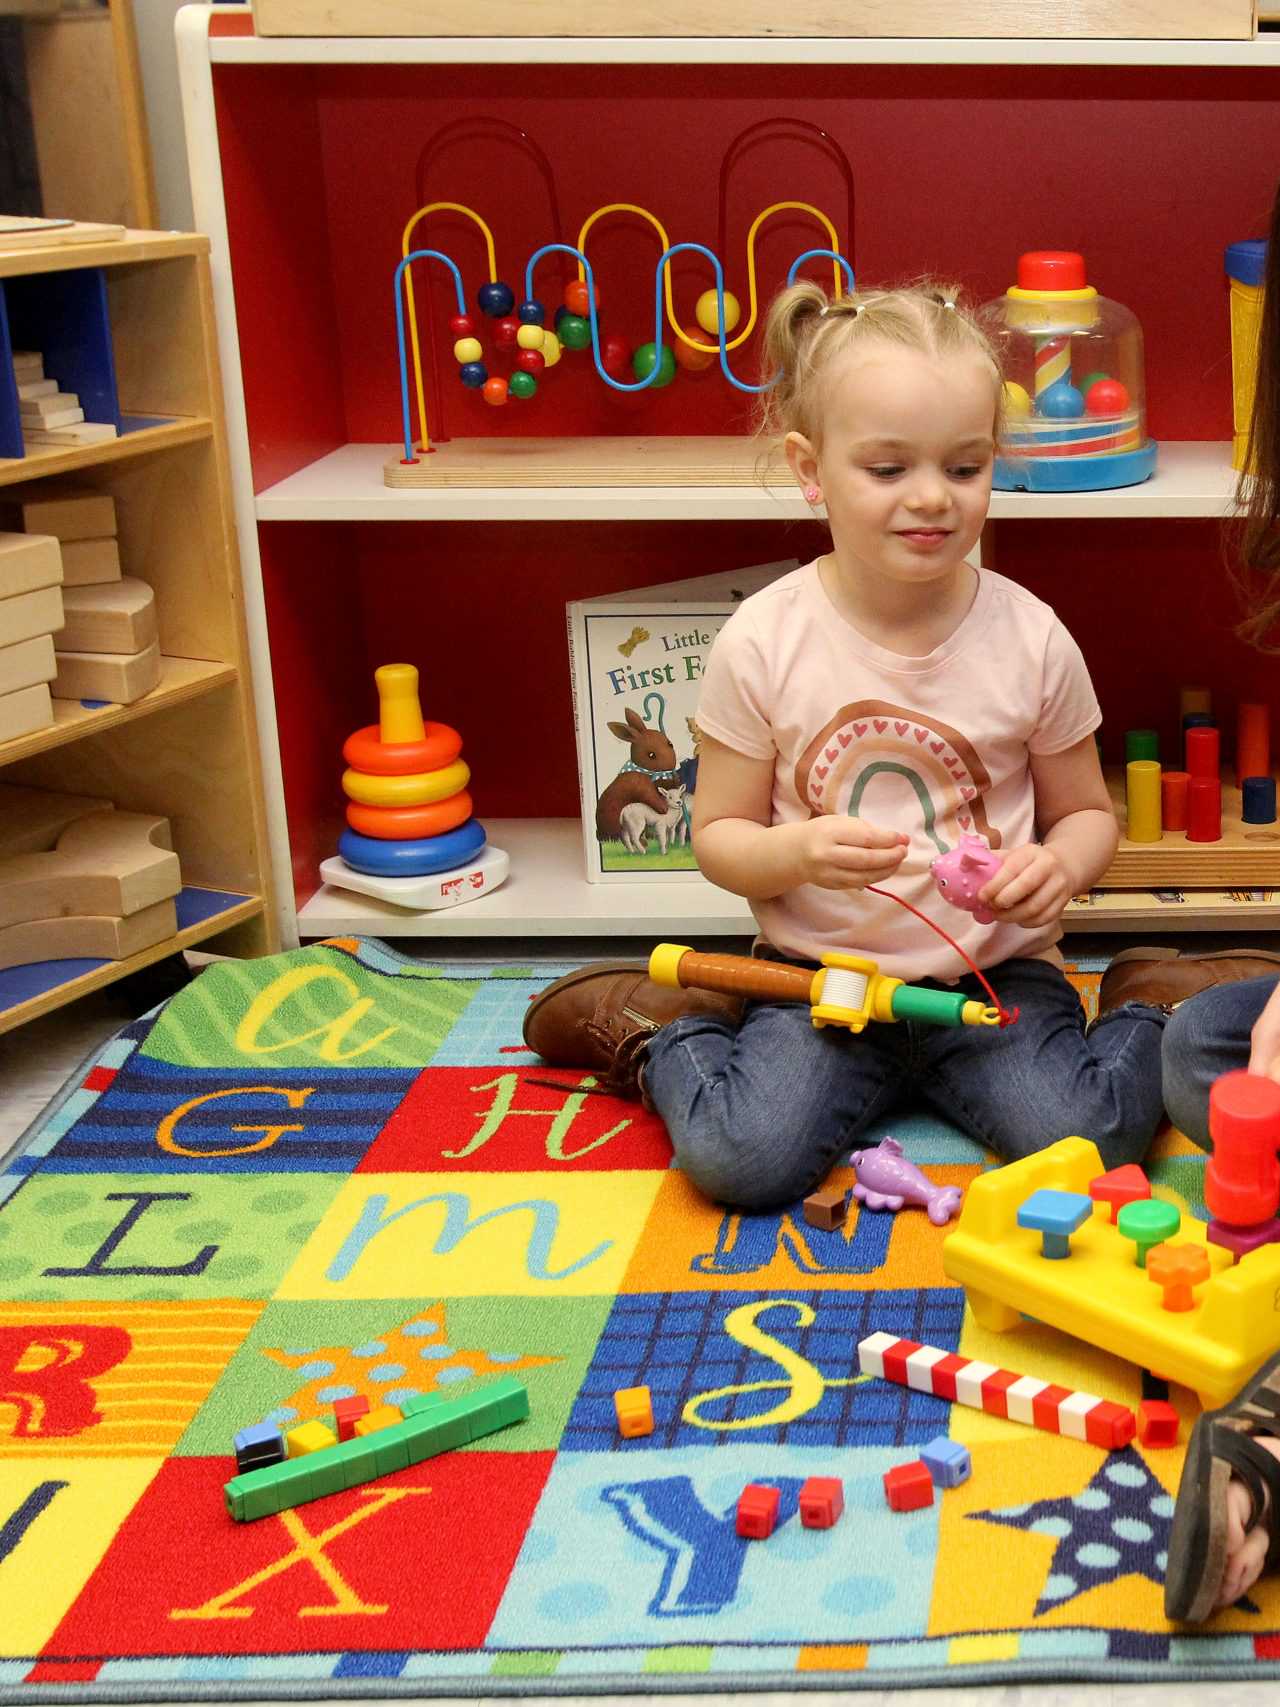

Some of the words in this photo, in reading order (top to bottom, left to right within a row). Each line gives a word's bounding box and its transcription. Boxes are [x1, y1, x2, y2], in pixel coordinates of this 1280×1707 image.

[606, 663, 676, 696] First
[661, 629, 710, 653] Little
[156, 1086, 317, 1158] G
[40, 1191, 220, 1277] L
[683, 1299, 872, 1430] S
[168, 1486, 432, 1620] X
[600, 1475, 808, 1618] Y
